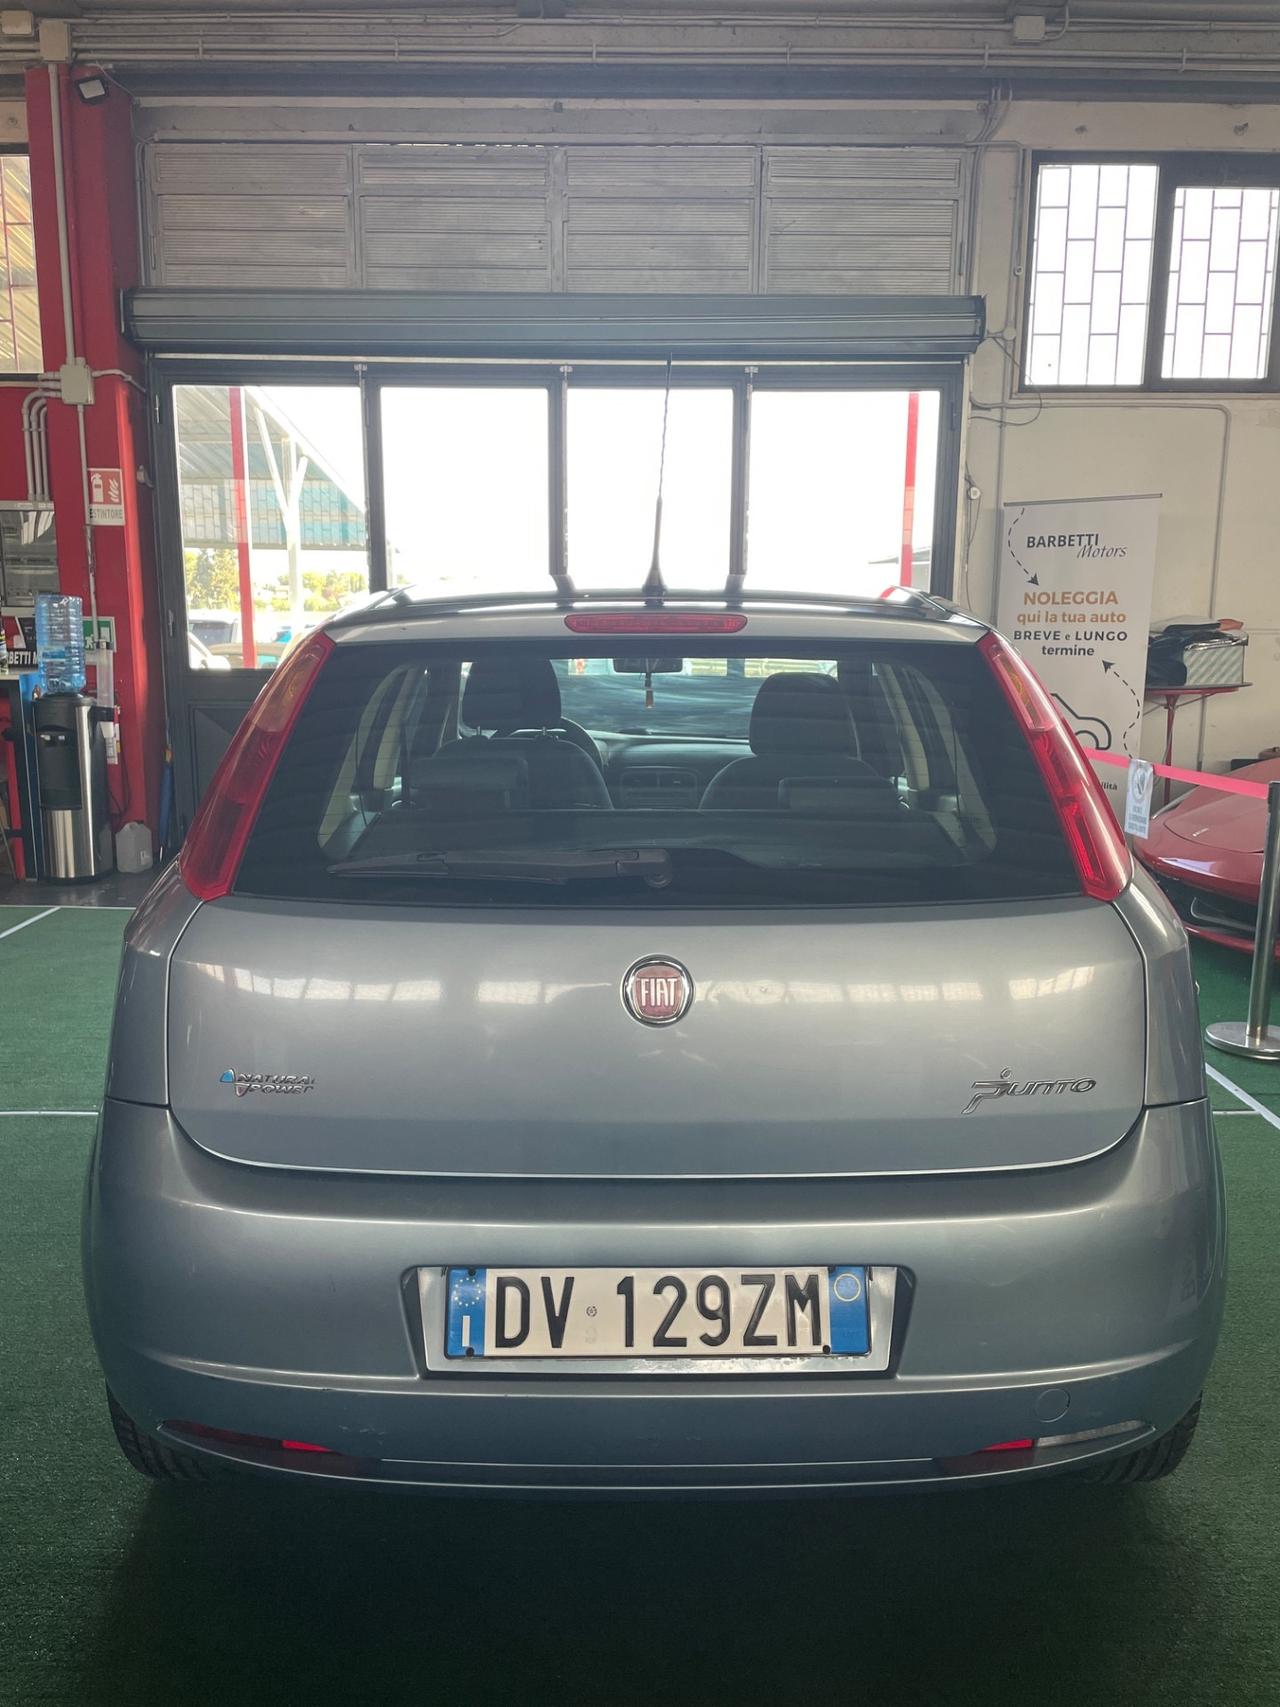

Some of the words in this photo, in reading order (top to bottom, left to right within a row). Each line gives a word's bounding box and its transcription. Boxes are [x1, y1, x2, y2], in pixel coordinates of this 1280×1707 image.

[89, 508, 123, 519] ESTINTORE
[1026, 533, 1099, 548] BARBETTI
[1077, 545, 1127, 558] Motors
[1023, 591, 1119, 605] NOLEGGIA
[1017, 610, 1041, 625] qui
[1045, 611, 1058, 623] la
[1062, 611, 1086, 623] tua
[1090, 611, 1126, 623] auto
[1014, 630, 1061, 641] BREVE
[1065, 632, 1071, 641] e
[1075, 630, 1128, 641] LUNGO
[1041, 645, 1095, 656] termine
[641, 977, 678, 1007] FIAT
[494, 1275, 575, 1349] DV
[616, 1274, 823, 1348] 129ZM
